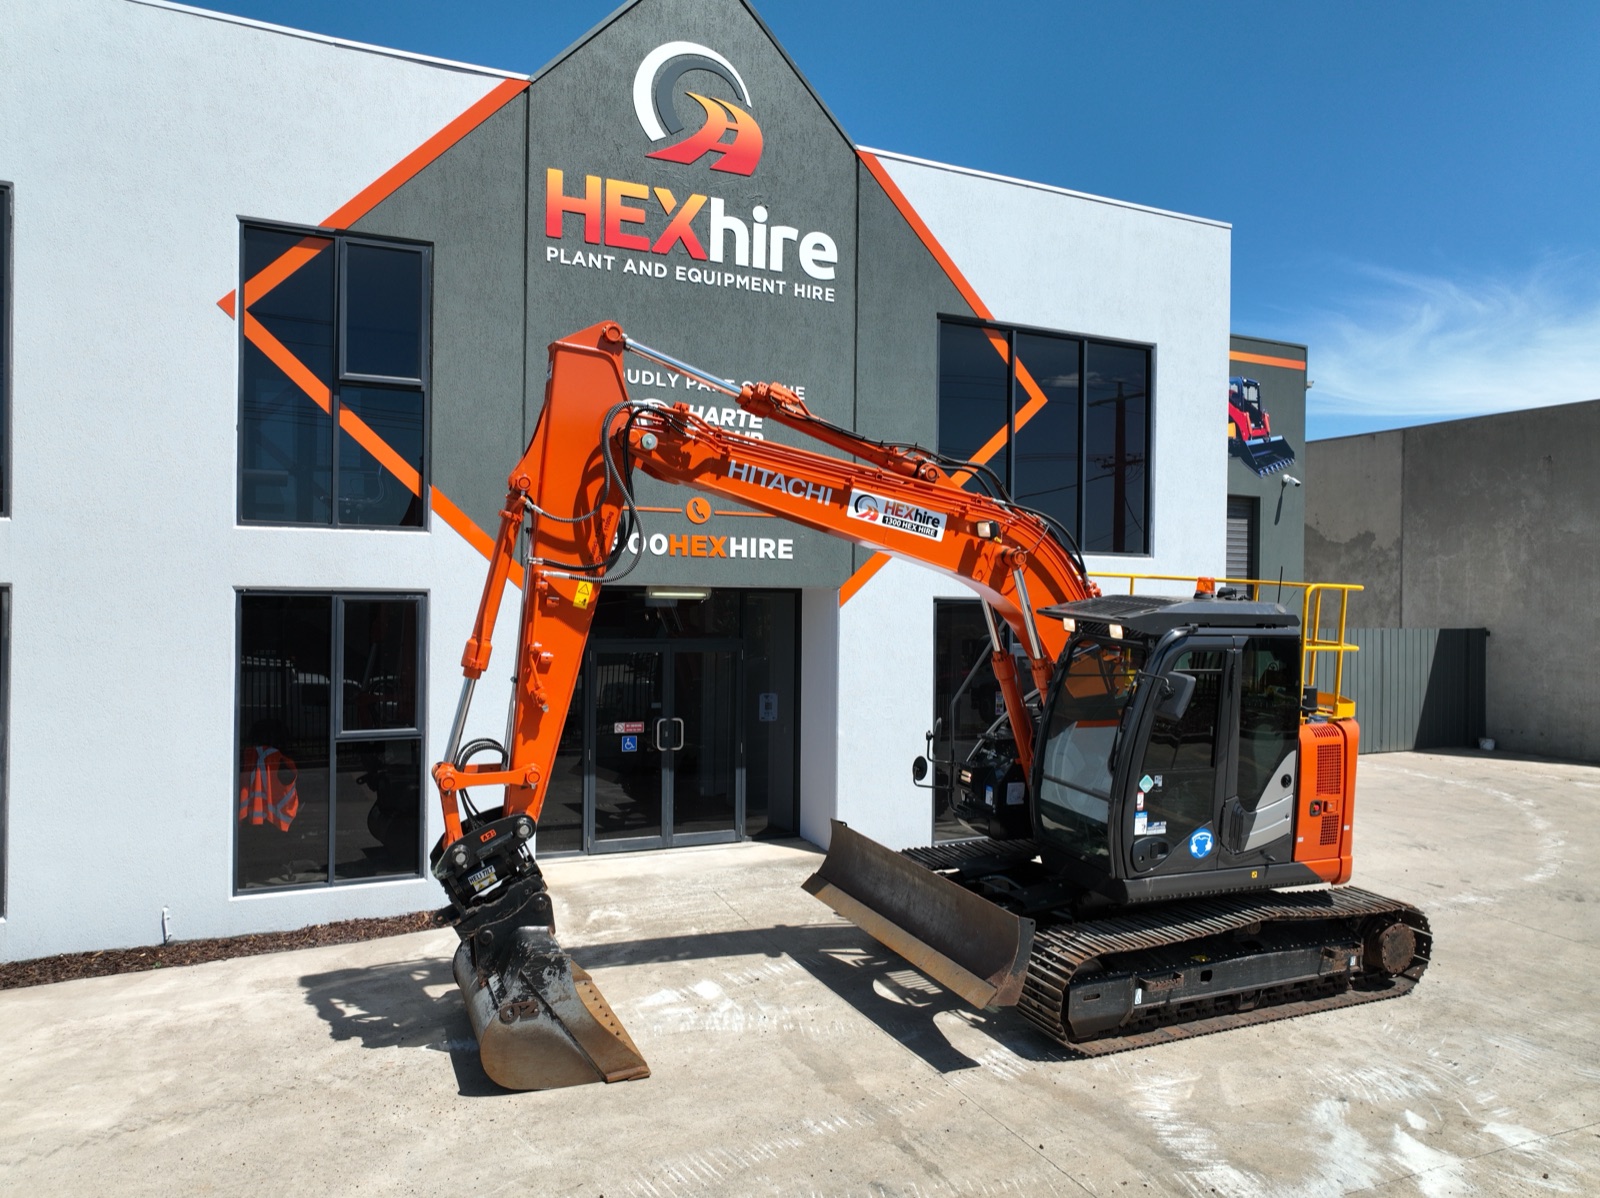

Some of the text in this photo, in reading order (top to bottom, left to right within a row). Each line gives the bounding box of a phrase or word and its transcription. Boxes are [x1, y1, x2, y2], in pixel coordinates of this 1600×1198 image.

[546, 168, 838, 281] HEXhire
[546, 246, 836, 303] PLANT AND EQUIPMENT HIRE
[624, 368, 680, 389] UDLY
[728, 460, 832, 506] HITACHI
[885, 501, 939, 528] HEXhire
[885, 517, 936, 537] 1300 HEX HIRE
